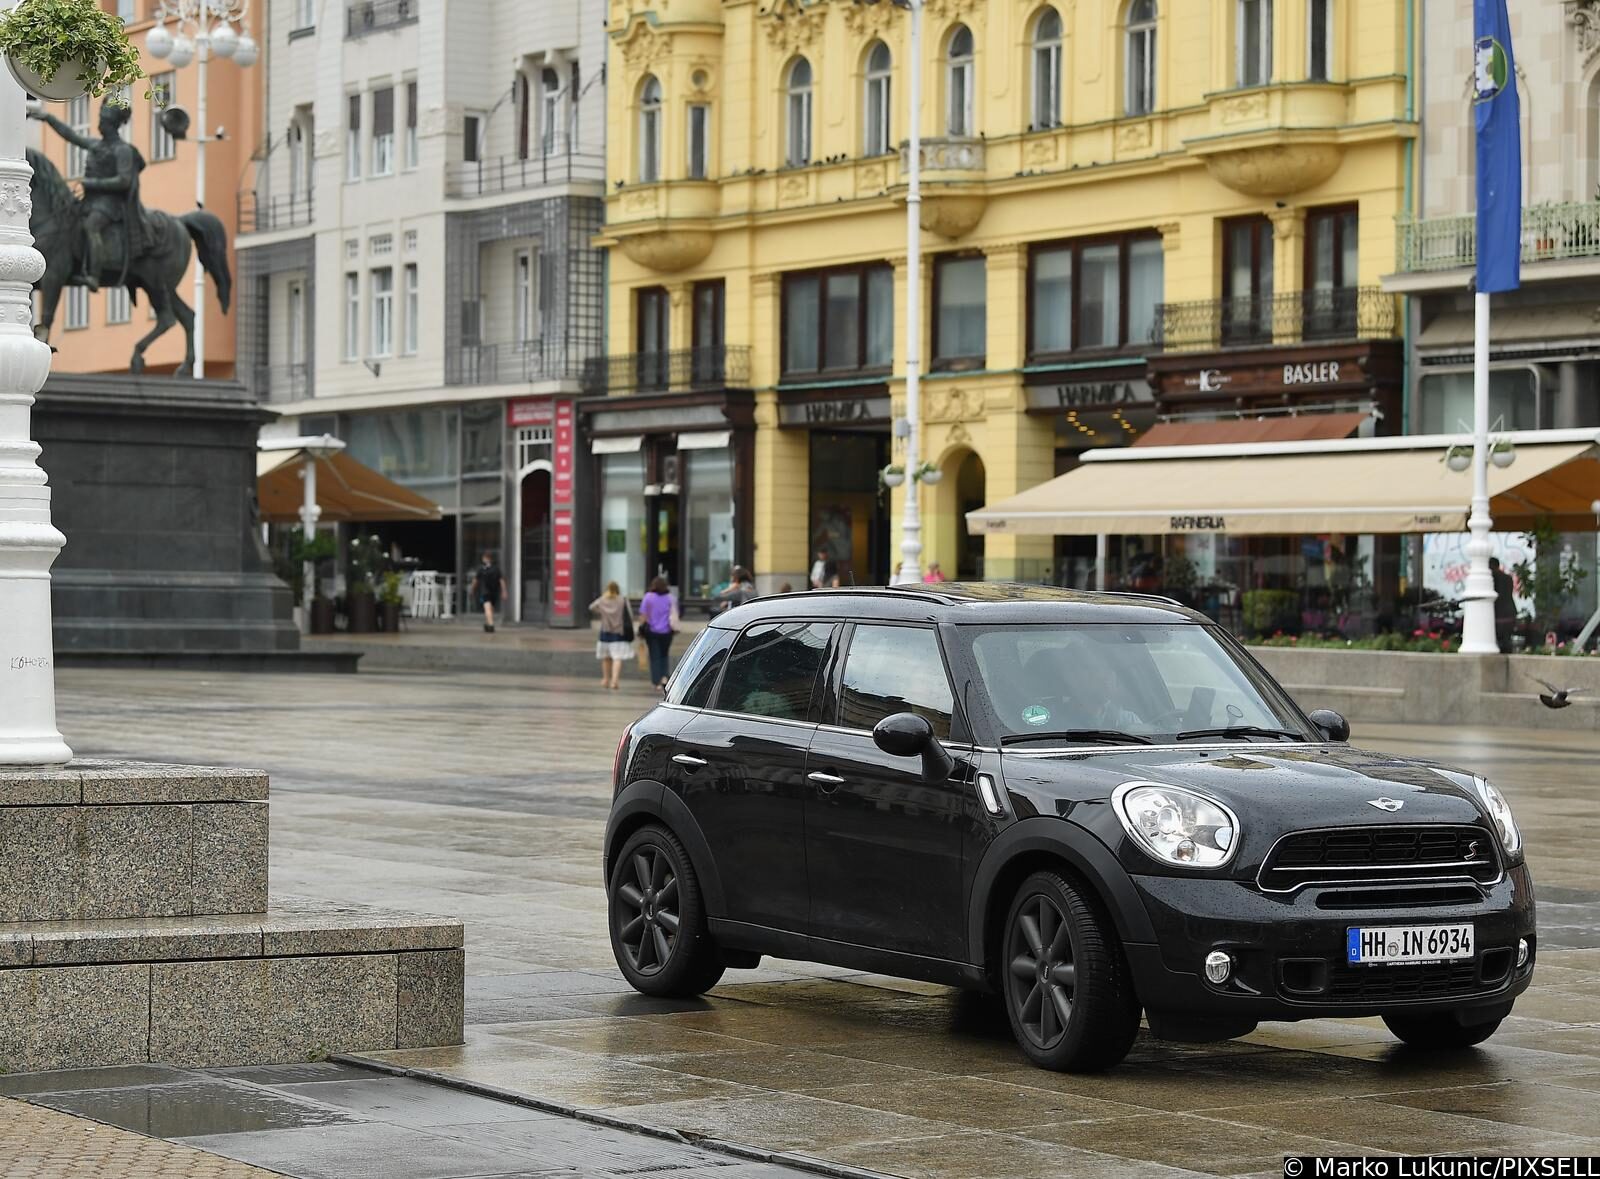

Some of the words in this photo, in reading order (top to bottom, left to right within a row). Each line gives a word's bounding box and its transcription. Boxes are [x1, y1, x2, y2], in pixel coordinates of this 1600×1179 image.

[1283, 361, 1340, 385] BASLER
[1361, 931, 1386, 957] HH
[1401, 930, 1423, 956] IN
[1427, 927, 1471, 955] 6934
